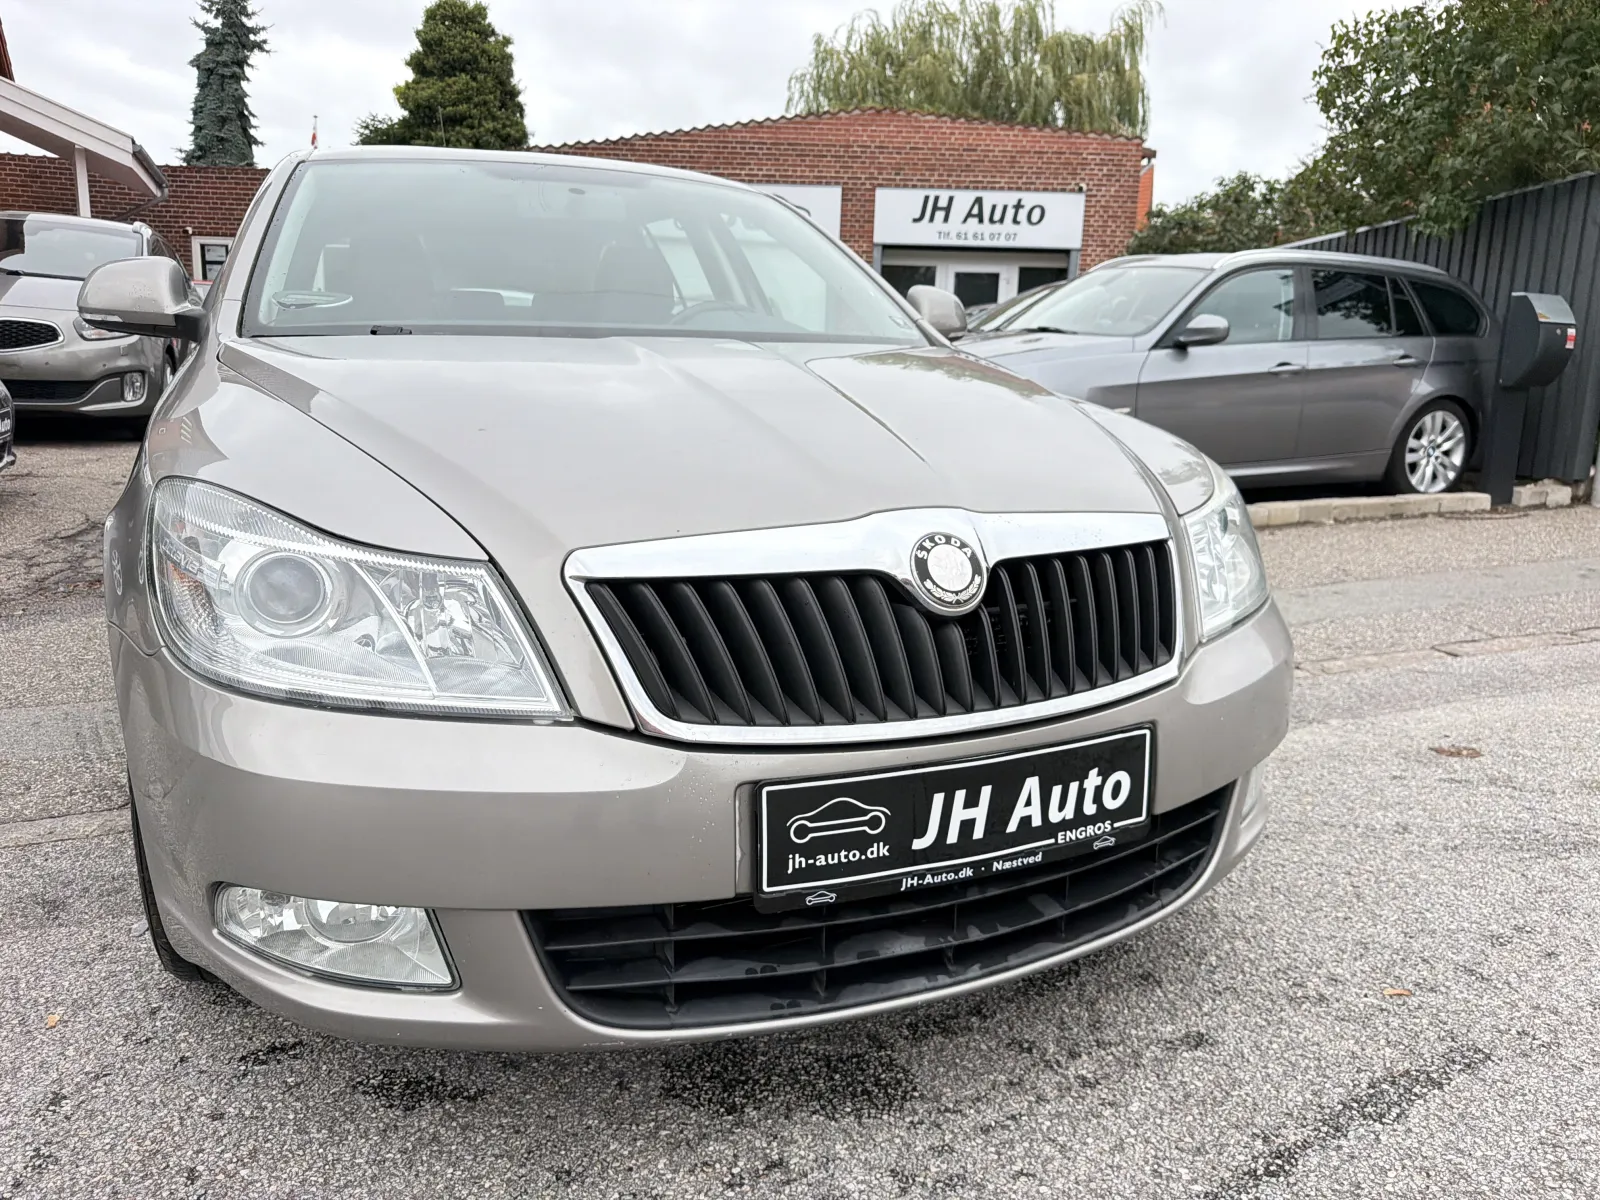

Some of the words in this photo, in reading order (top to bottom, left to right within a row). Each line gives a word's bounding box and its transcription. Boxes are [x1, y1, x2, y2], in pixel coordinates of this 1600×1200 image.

[911, 194, 954, 224] JH
[961, 196, 1046, 226] Auto
[936, 231, 953, 241] Tlf.
[956, 231, 968, 241] 61
[972, 232, 985, 242] 61
[988, 232, 1002, 242] 07
[1004, 232, 1018, 242] 07
[911, 784, 993, 850] JH
[1005, 767, 1132, 834] Auto
[1057, 820, 1112, 844] ENGROS
[787, 842, 890, 875] jh-auto.dk
[900, 868, 974, 891] JH-Auto.dk
[992, 852, 1043, 872] Næstved
